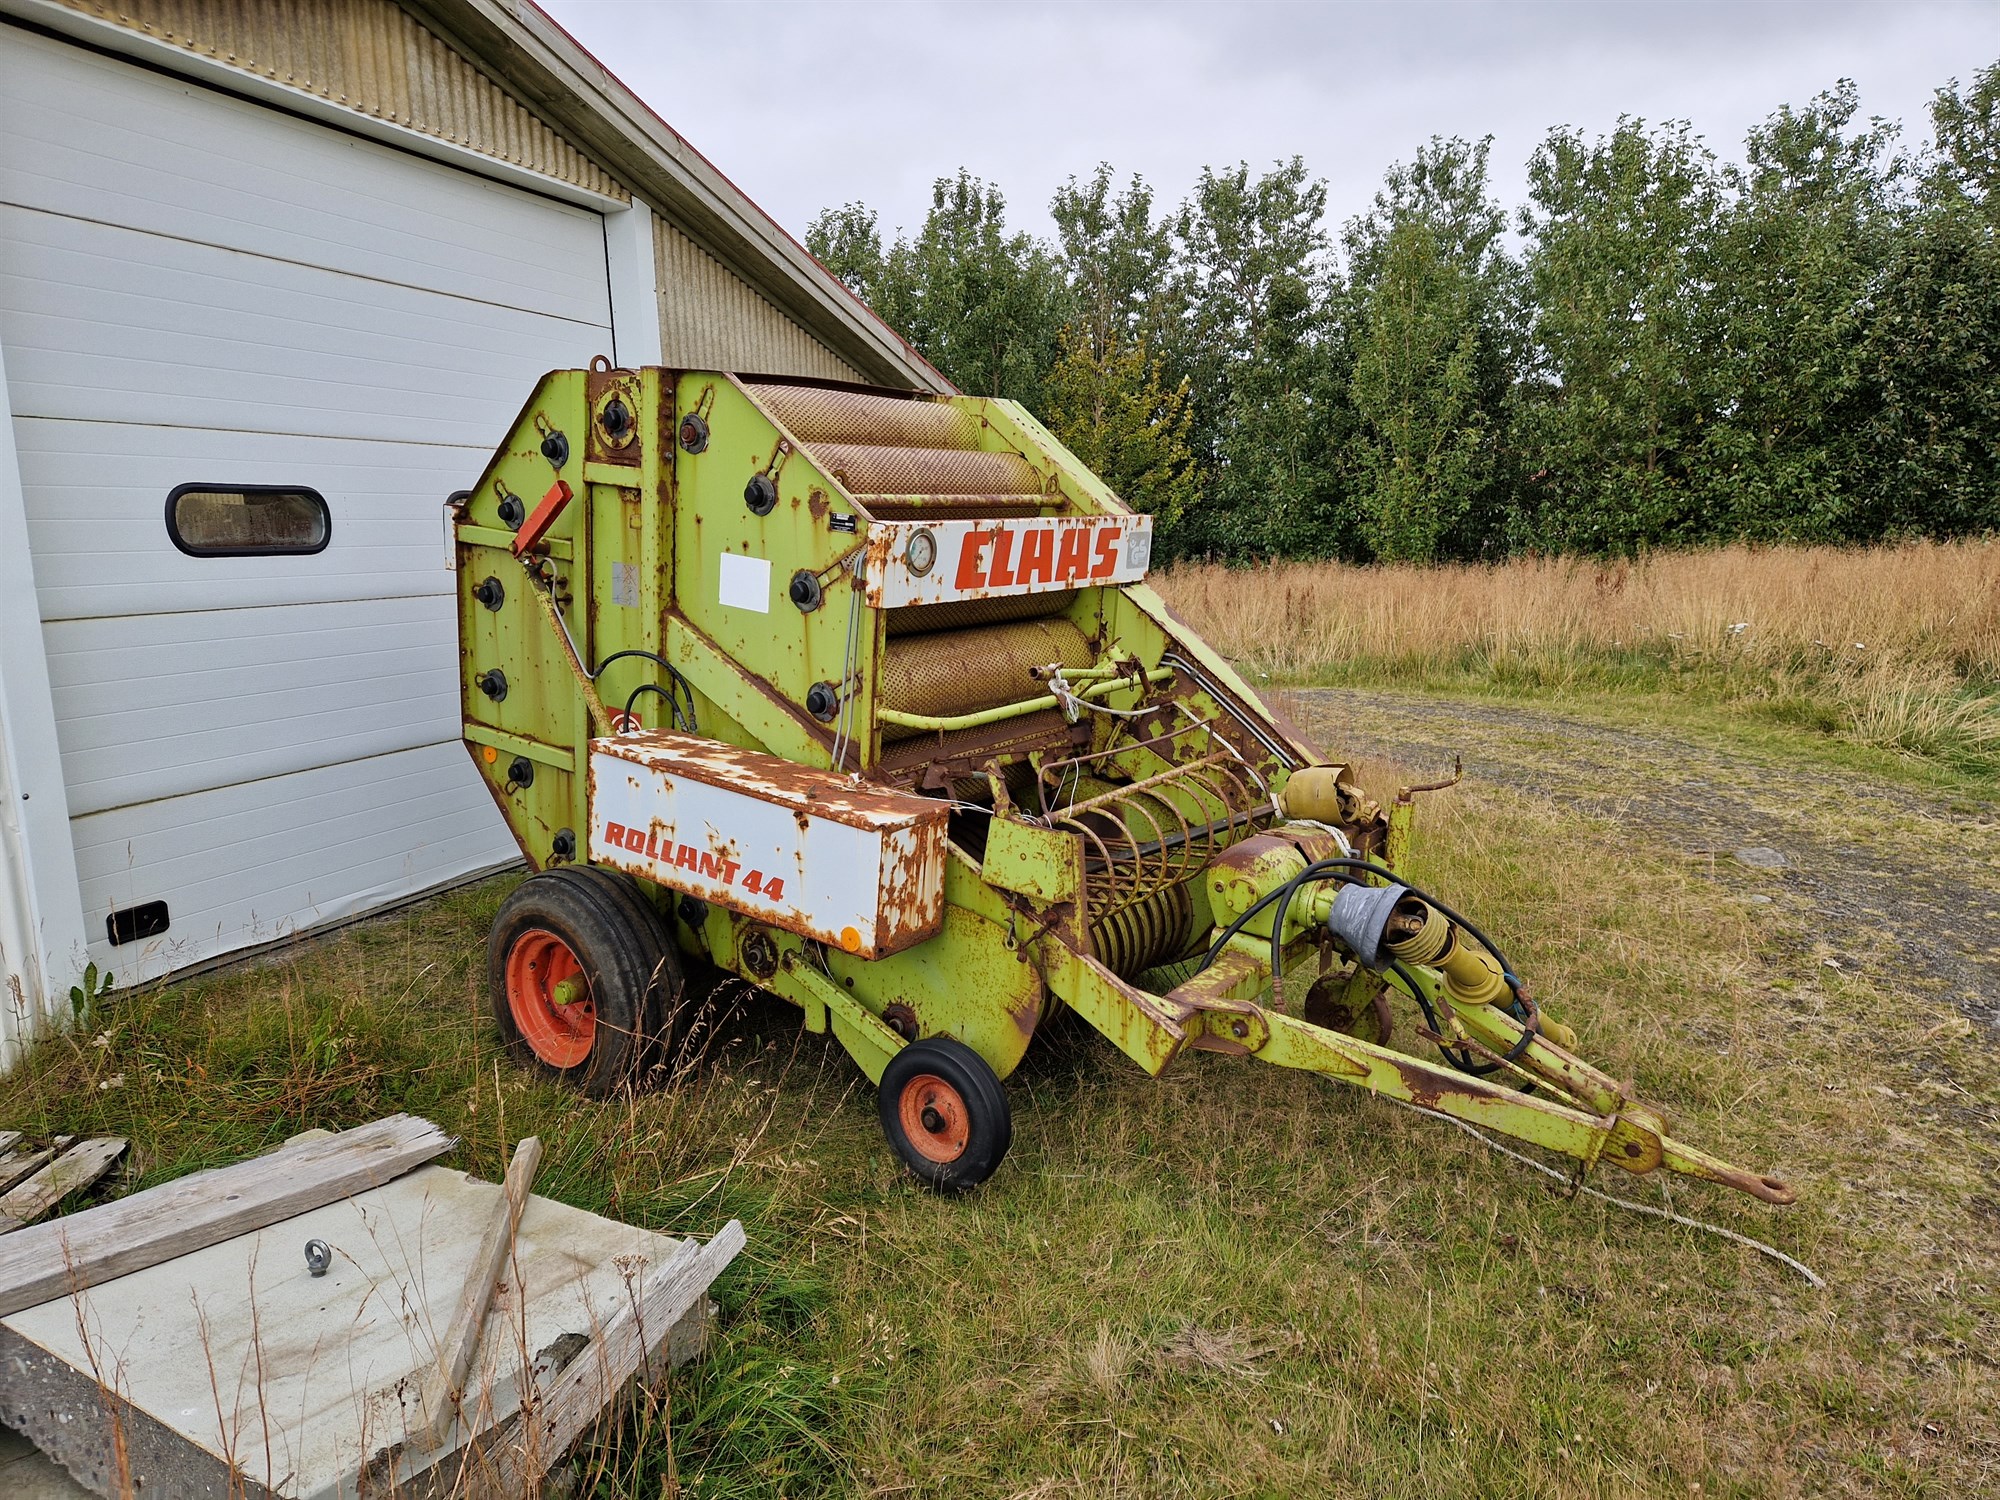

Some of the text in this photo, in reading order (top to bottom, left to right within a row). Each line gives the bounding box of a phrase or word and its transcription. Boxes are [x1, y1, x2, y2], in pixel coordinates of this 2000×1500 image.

[955, 527, 1121, 590] CLAAS
[604, 821, 785, 902] ROLLANT 44
